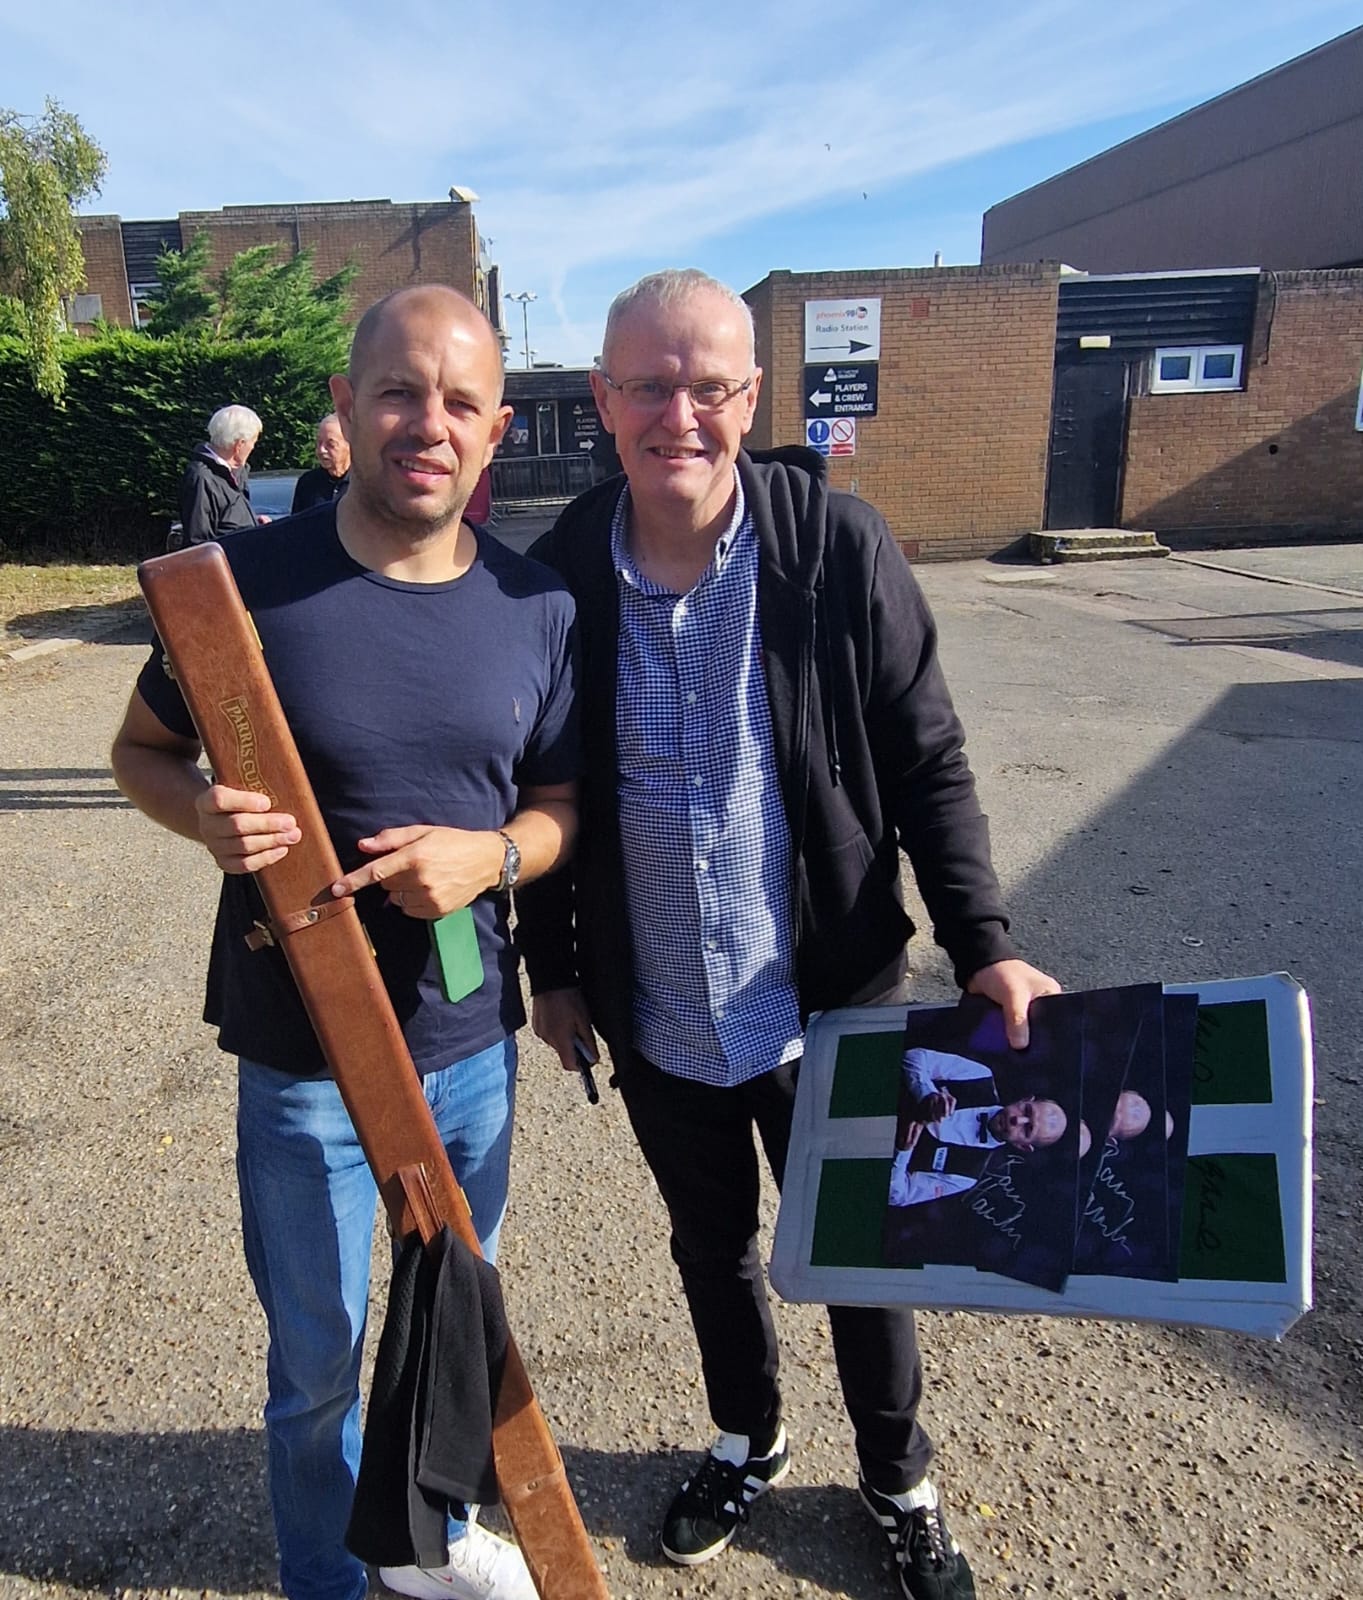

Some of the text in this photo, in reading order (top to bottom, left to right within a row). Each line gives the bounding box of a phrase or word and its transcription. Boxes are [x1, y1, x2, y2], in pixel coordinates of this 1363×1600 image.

[816, 323, 869, 333] Radio Station
[834, 383, 868, 392] PLAYERS
[834, 393, 865, 402] & CREW
[834, 403, 874, 412] ENTRANCE
[226, 703, 255, 758] PARRIS
